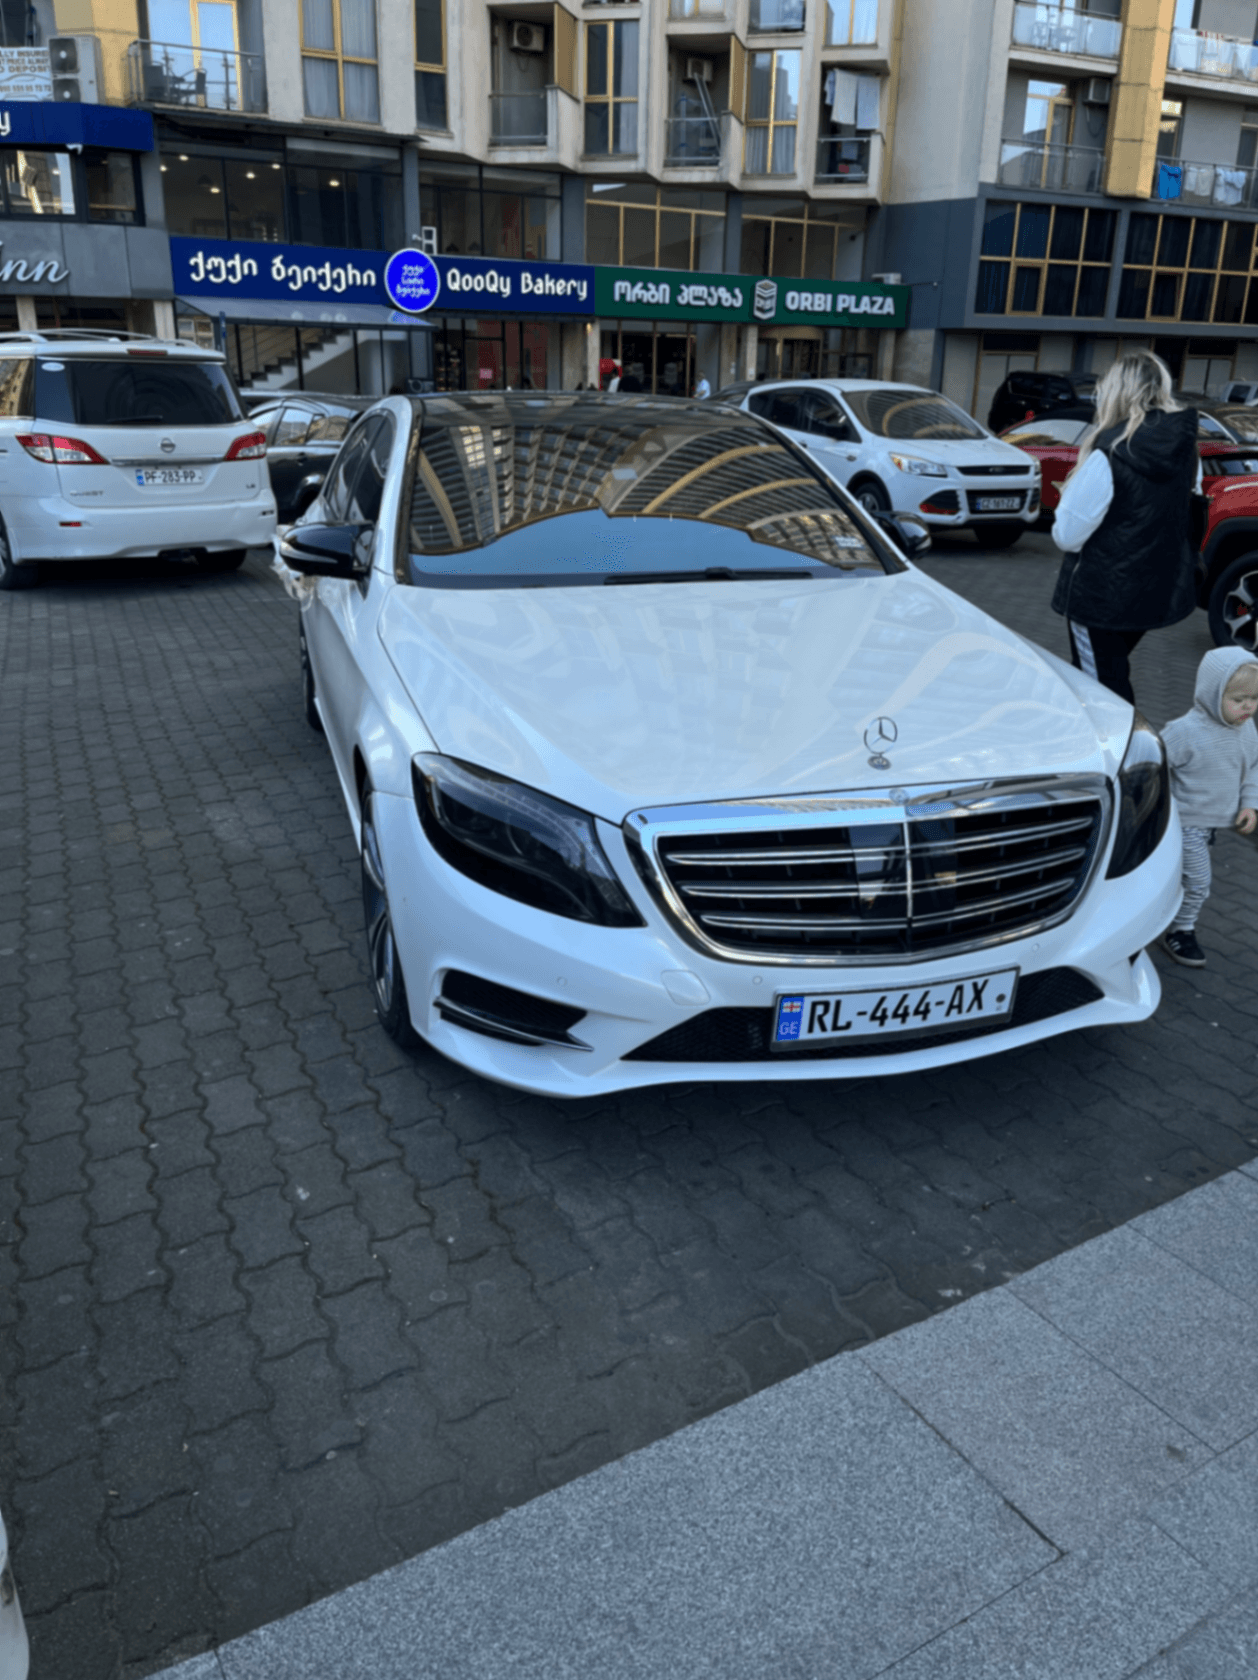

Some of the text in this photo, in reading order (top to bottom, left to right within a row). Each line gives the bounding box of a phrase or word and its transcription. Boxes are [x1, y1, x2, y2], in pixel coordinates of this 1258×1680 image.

[189, 250, 377, 293] ქუქი ბეიქერი
[447, 267, 588, 301] QooQy Bakery
[785, 290, 895, 315] ORBI PLAZA
[144, 470, 196, 483] PF-283-PP
[807, 979, 989, 1034] RL-444-AX
[779, 1021, 798, 1036] GE
